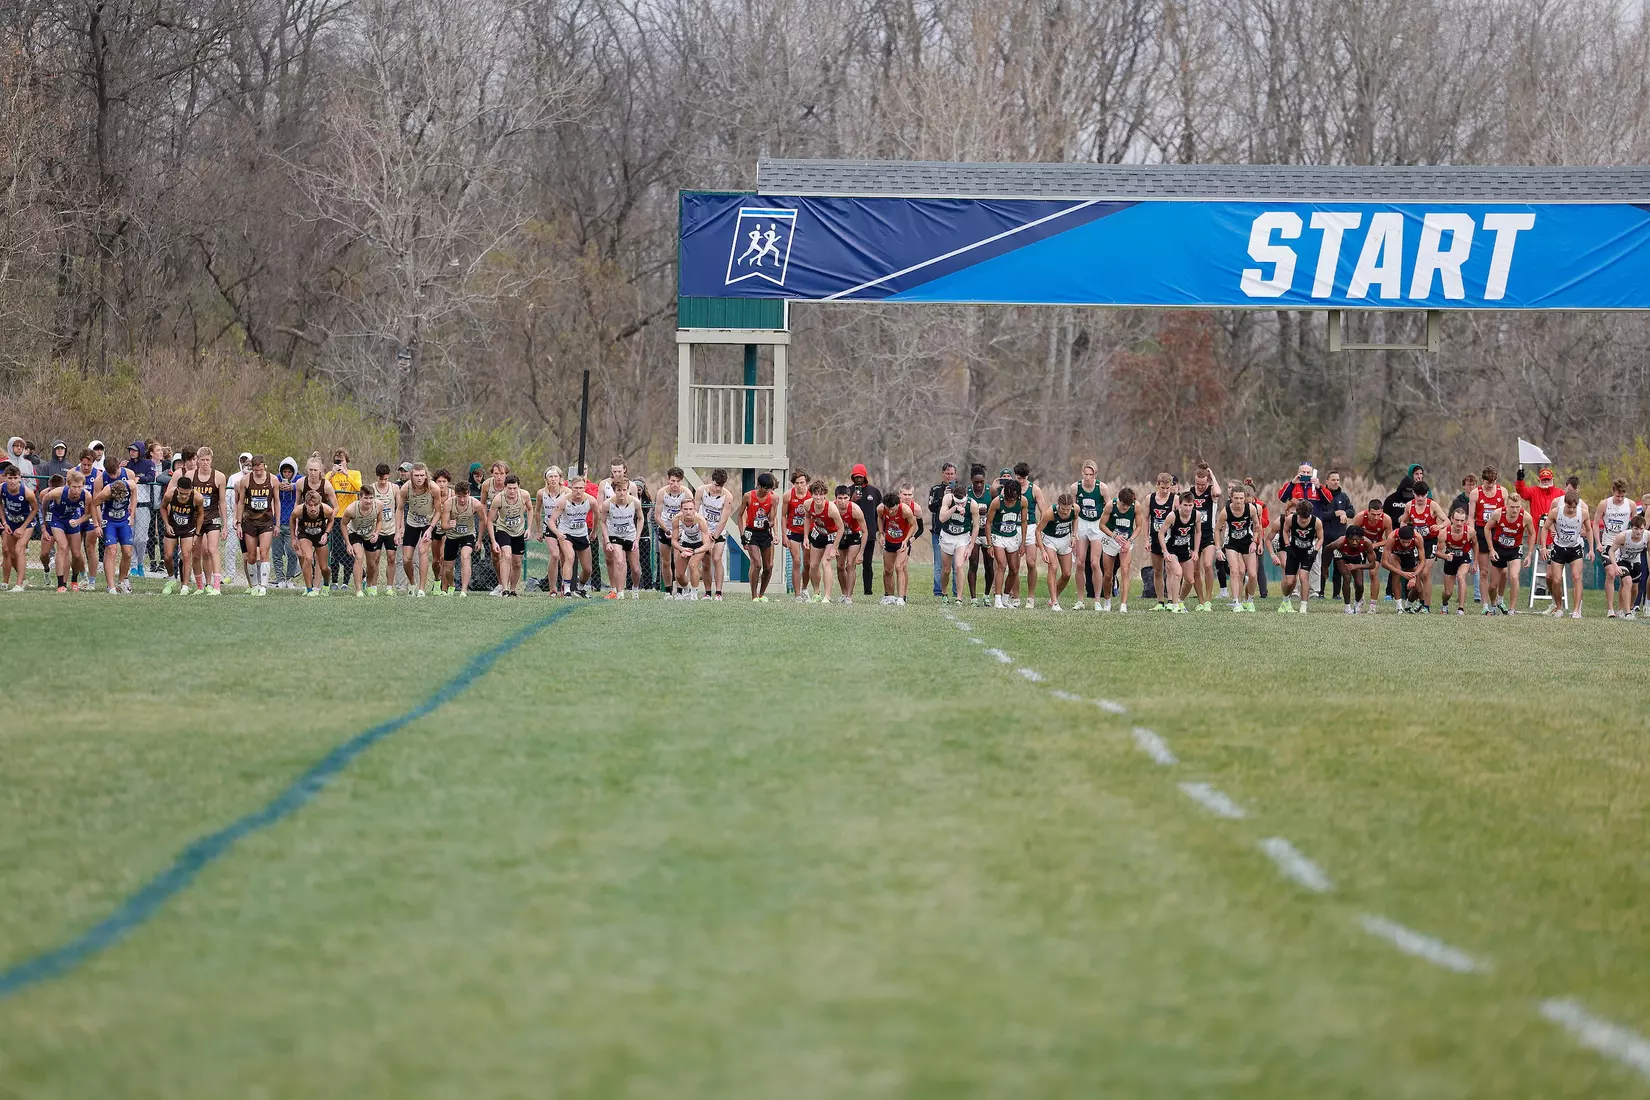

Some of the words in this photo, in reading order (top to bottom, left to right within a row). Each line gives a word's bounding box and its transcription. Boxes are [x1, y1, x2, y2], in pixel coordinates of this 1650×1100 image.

[1240, 211, 1536, 300] START
[250, 488, 270, 497] VALPO
[172, 505, 191, 515] VALPO
[251, 501, 266, 509] 502
[1002, 511, 1018, 522] OHIO
